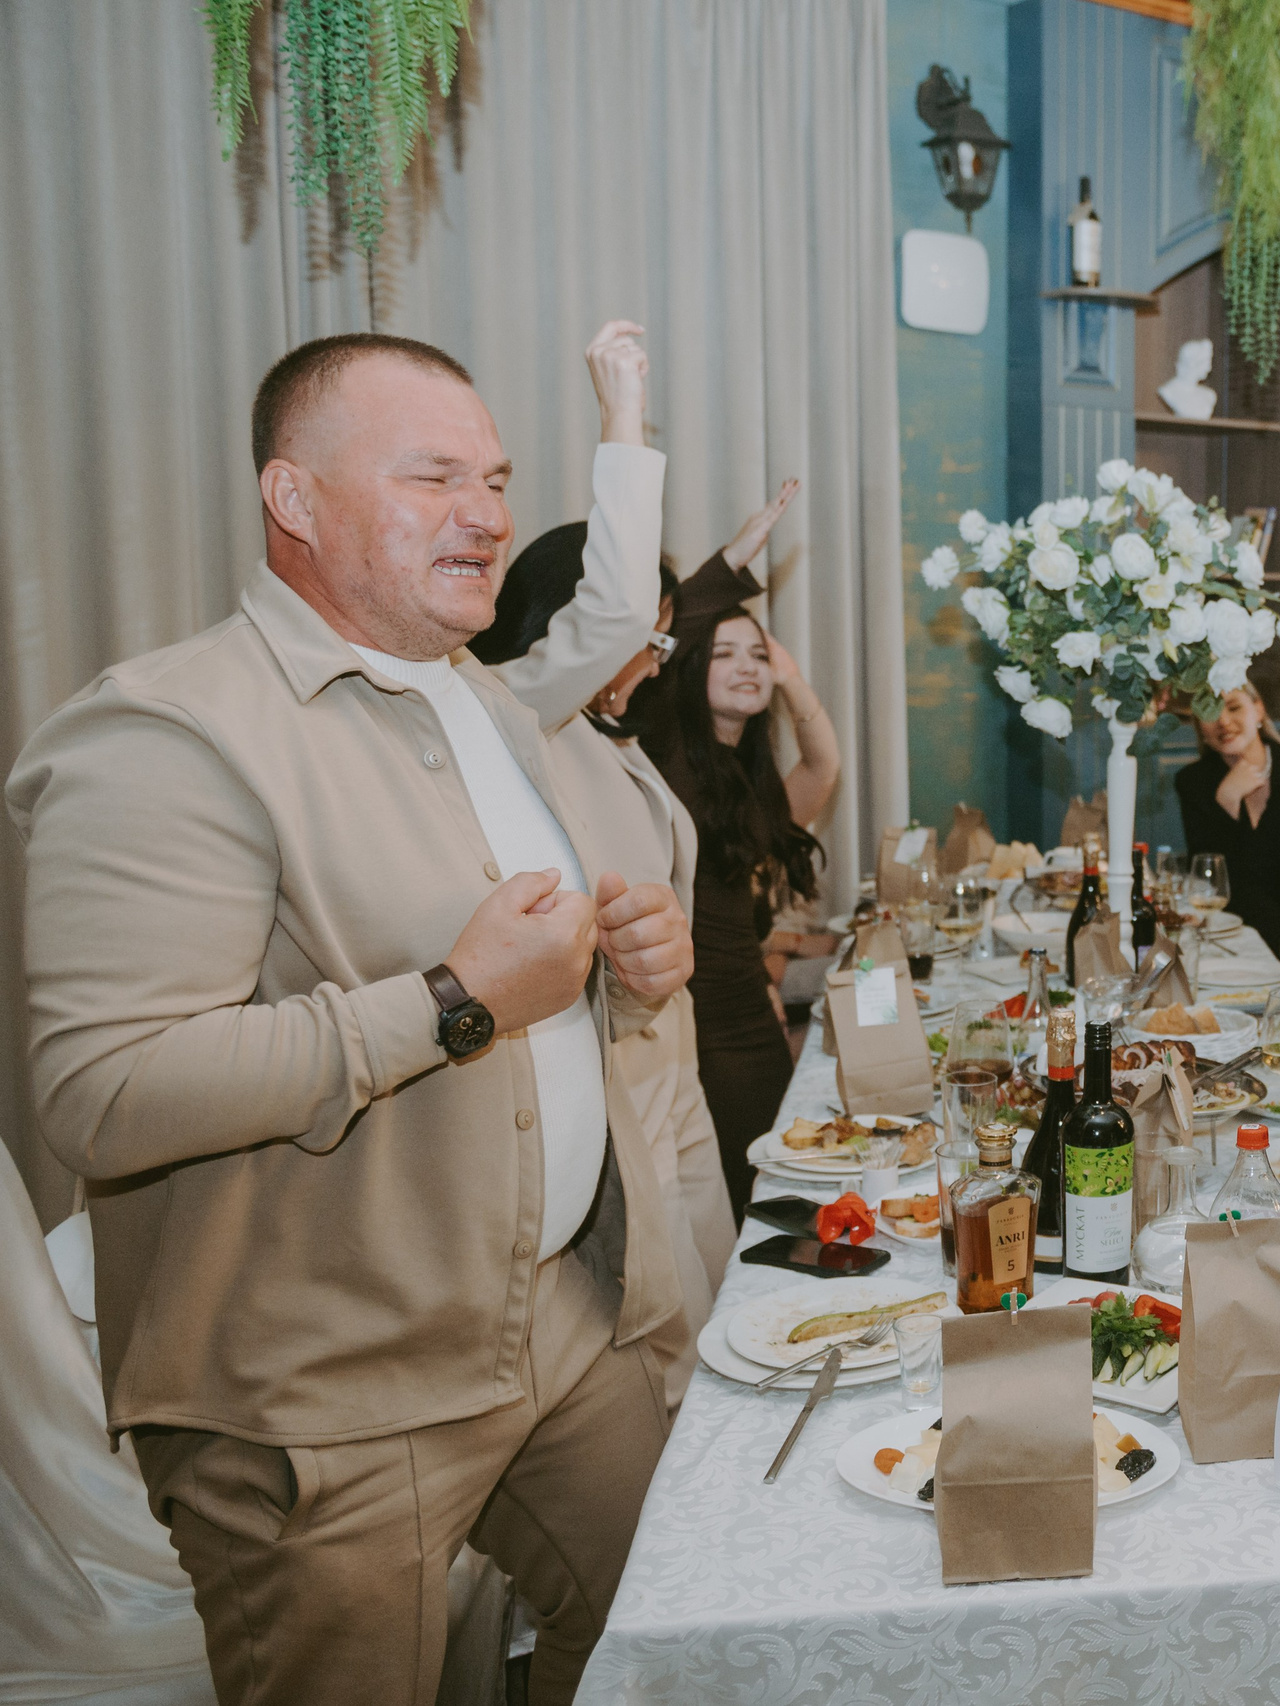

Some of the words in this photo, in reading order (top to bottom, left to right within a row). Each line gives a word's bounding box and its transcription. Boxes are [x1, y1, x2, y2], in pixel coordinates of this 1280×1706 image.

[995, 1230, 1025, 1247] ANRI
[1075, 1206, 1085, 1261] МУСКАТ
[1007, 1259, 1015, 1271] 5
